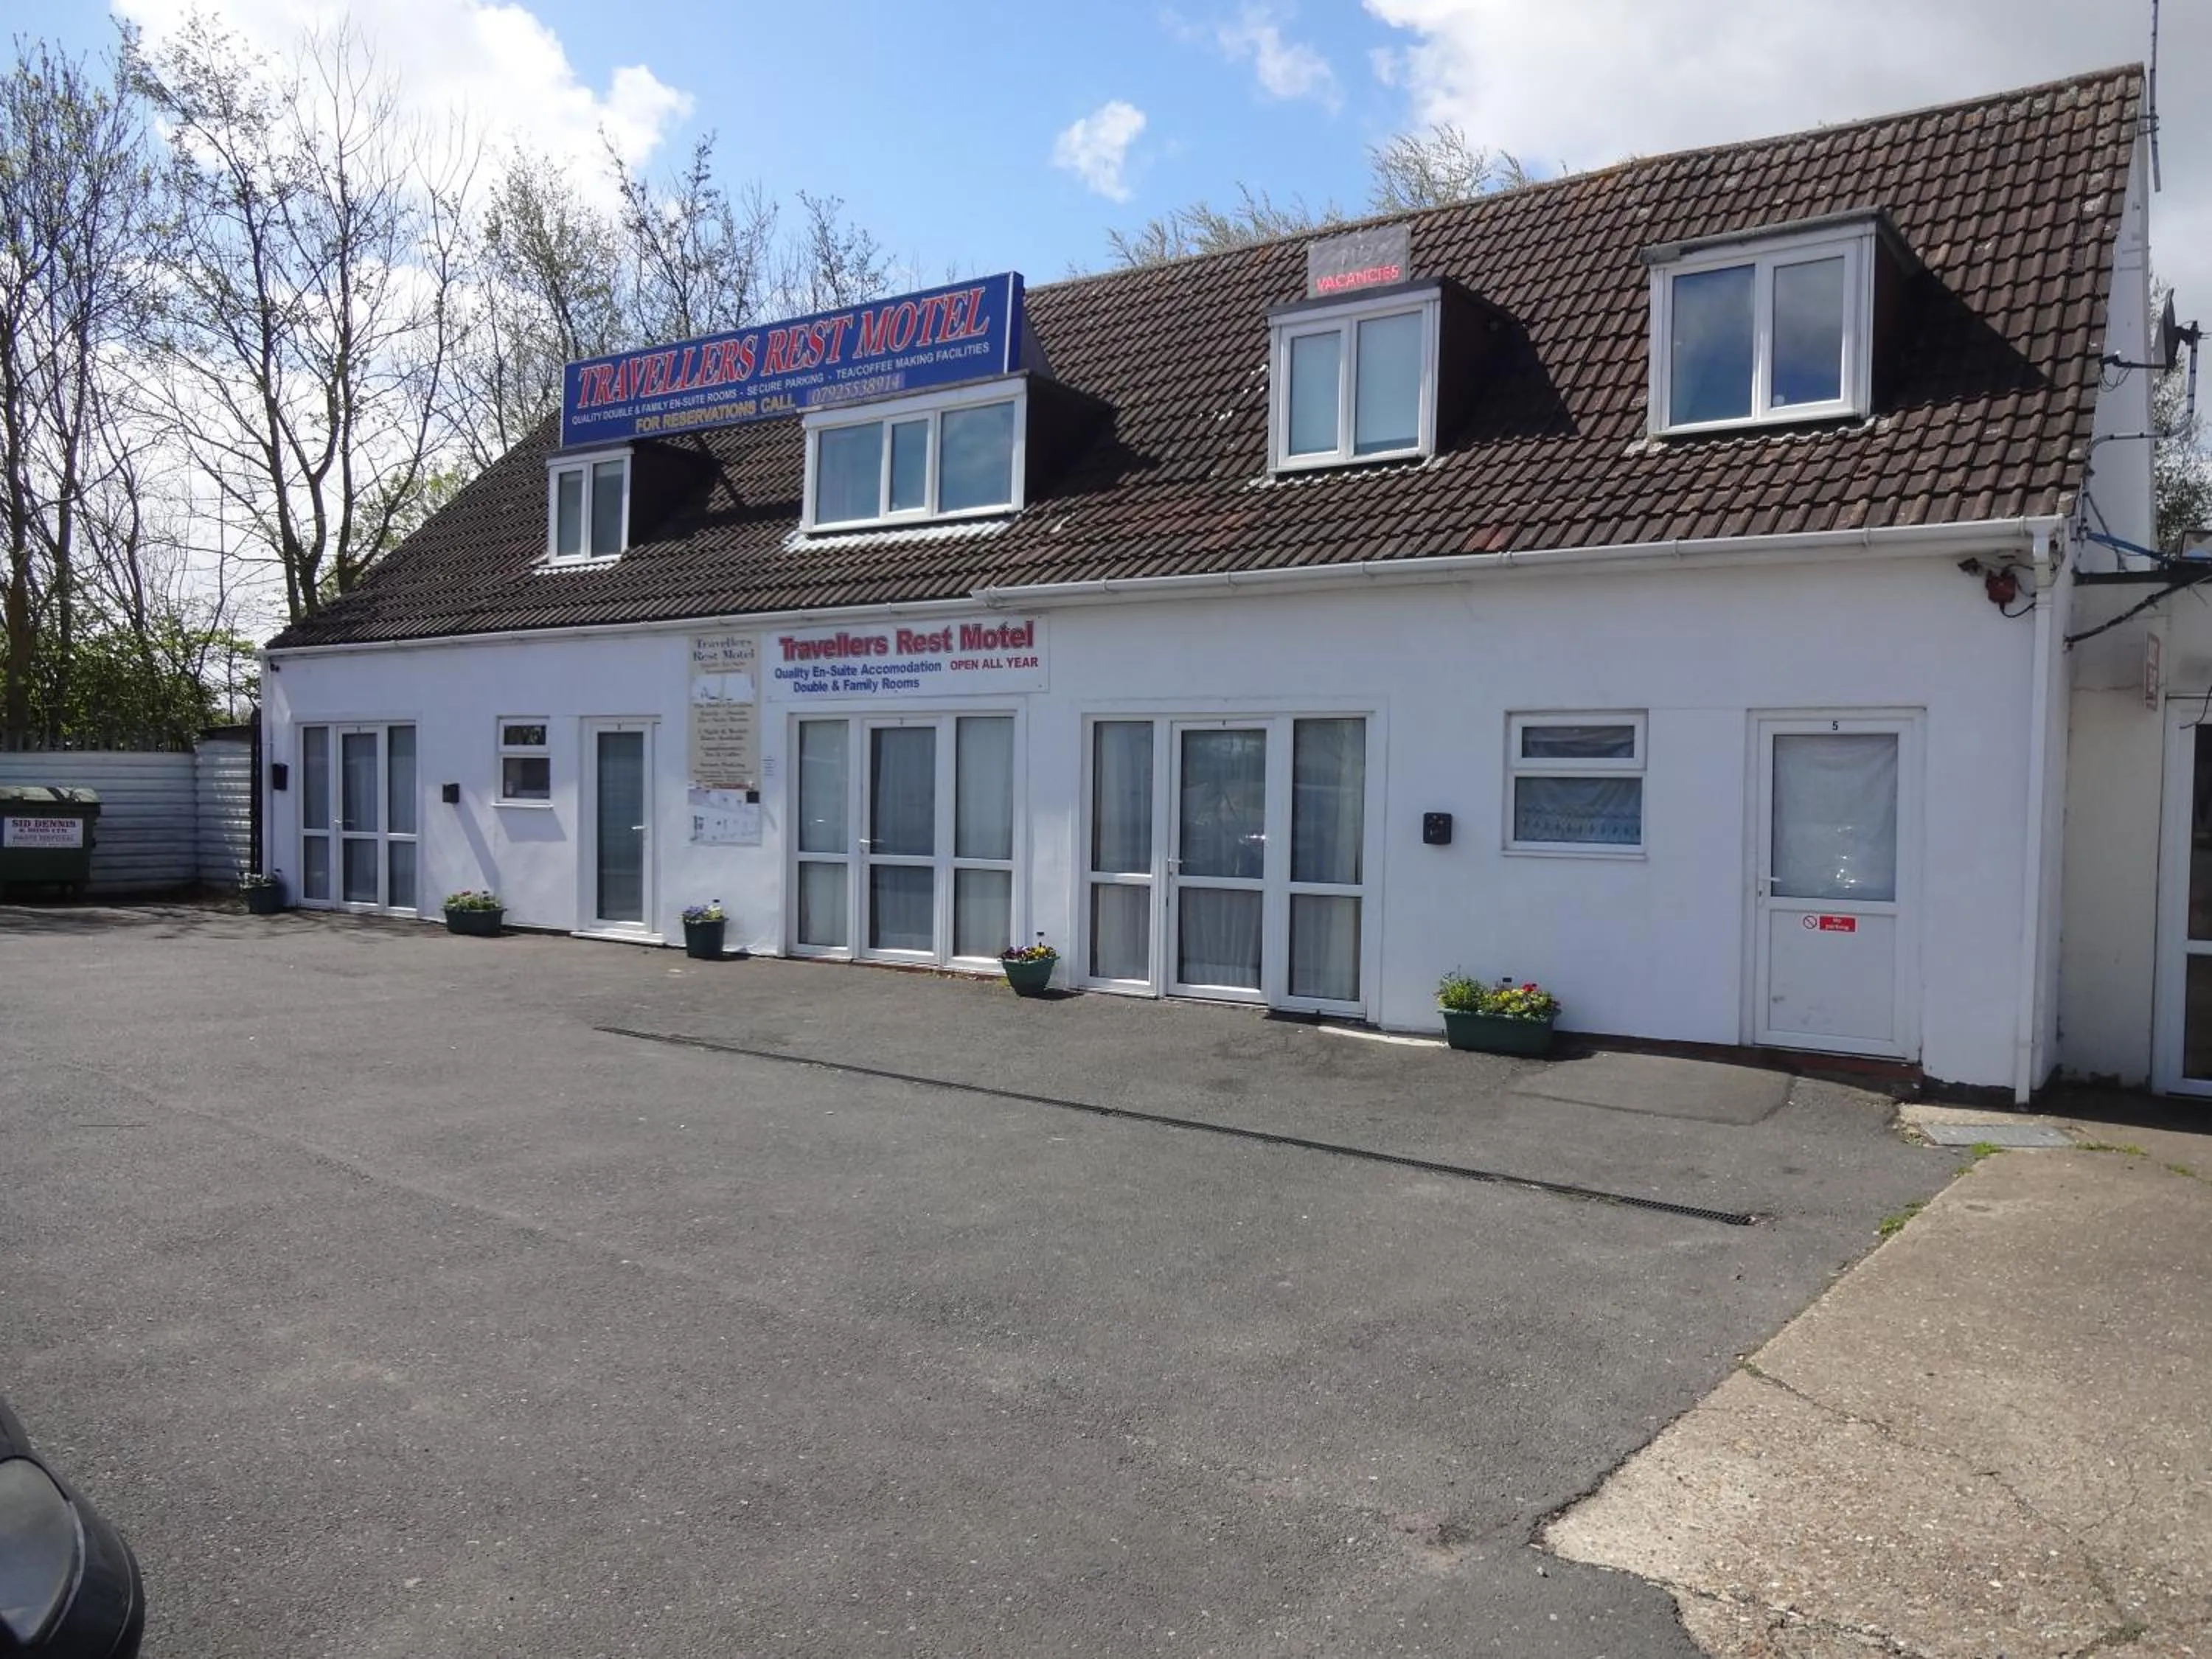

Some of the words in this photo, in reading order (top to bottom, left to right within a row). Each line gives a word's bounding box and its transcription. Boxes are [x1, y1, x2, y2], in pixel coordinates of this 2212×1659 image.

[1316, 265, 1399, 293] VACANCIES
[577, 334, 759, 409] TRAVELLERS
[759, 314, 854, 377] REST
[852, 286, 991, 360] MOTEL
[571, 412, 602, 425] QUALITY
[602, 408, 634, 420] DOUBLE
[634, 406, 641, 415] &
[641, 402, 668, 414] FAMILY
[669, 394, 706, 409] EN-SUITE
[707, 389, 737, 401] ROOMS
[747, 380, 782, 397] SECURE
[785, 372, 824, 389] PARKING
[836, 359, 893, 380] TEA/COFFEE
[895, 352, 934, 369] MAKING
[936, 341, 990, 361] FACILITIES
[636, 415, 663, 434] FOR
[664, 400, 757, 430] RESERVATIONS
[760, 394, 796, 414] CALL
[778, 631, 889, 661] Travellers
[896, 625, 953, 655] Rest
[959, 620, 1034, 651] Motel
[774, 667, 810, 681] Quality
[812, 664, 858, 678] En-Suite
[860, 660, 942, 676] Accomodation
[950, 659, 979, 671] OPEN
[981, 658, 1004, 669] ALL
[1006, 656, 1039, 669] YEAR
[793, 681, 828, 693] Double
[831, 680, 840, 692] &
[843, 678, 879, 693] Family
[882, 677, 919, 690] Rooms
[1832, 720, 1839, 731] 5
